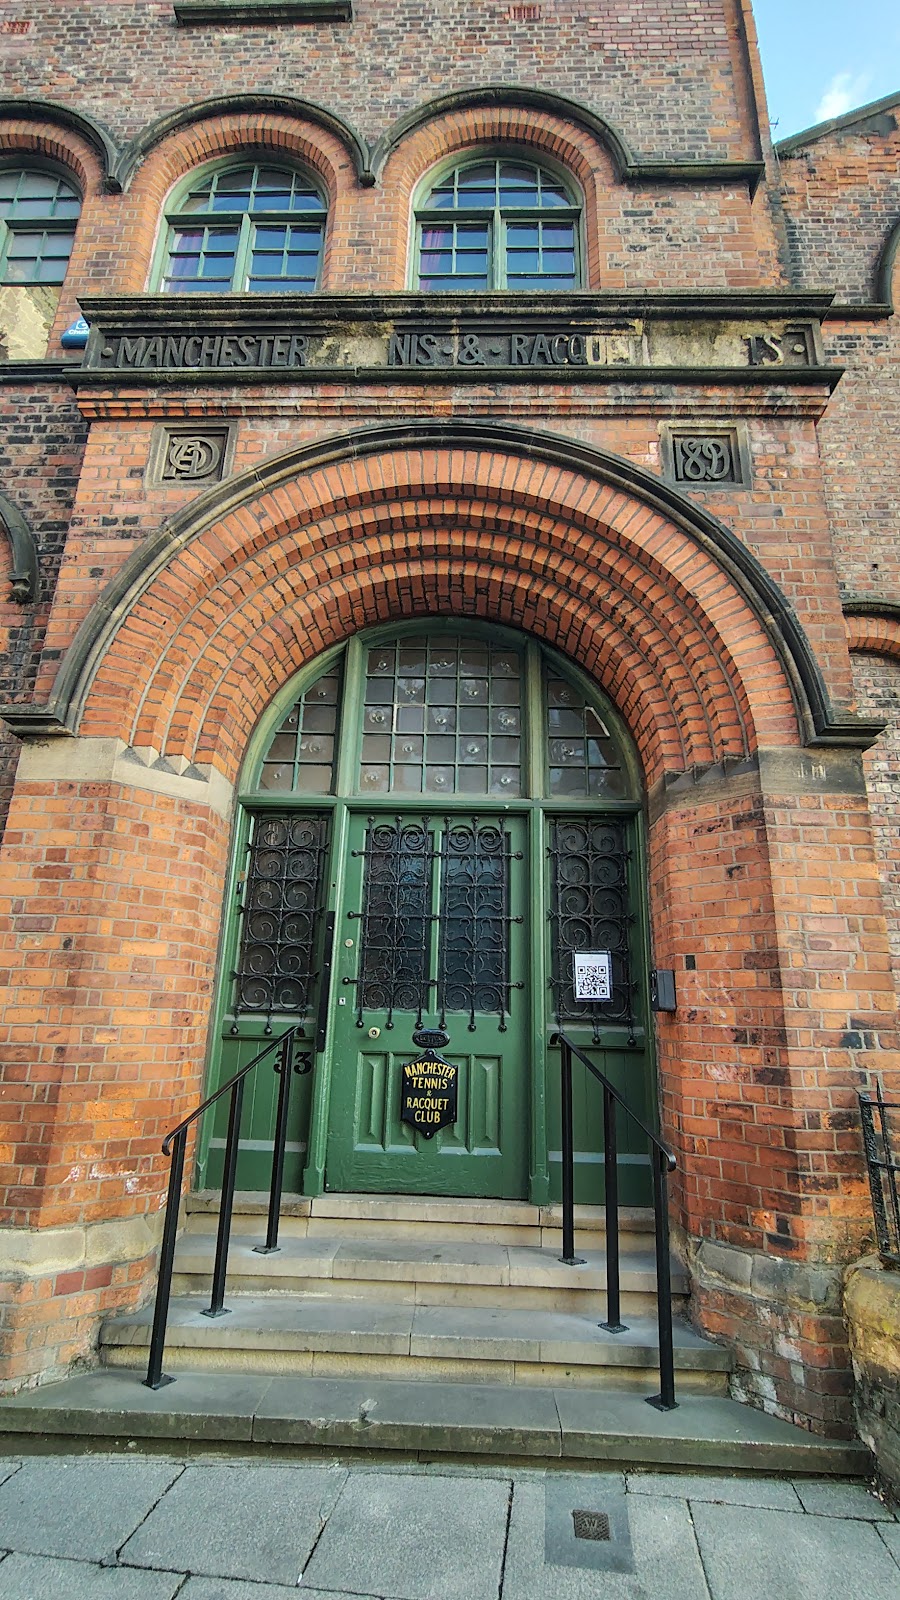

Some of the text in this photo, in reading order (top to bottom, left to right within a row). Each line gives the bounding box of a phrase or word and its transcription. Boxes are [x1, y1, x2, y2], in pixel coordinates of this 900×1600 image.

[116, 334, 309, 367] MANCHESTER
[458, 334, 486, 365] &
[404, 1061, 456, 1080] MANCHESTER
[412, 1077, 448, 1090] TENNIS
[406, 1097, 449, 1111] RACQUET
[414, 1110, 441, 1123] CLUB
